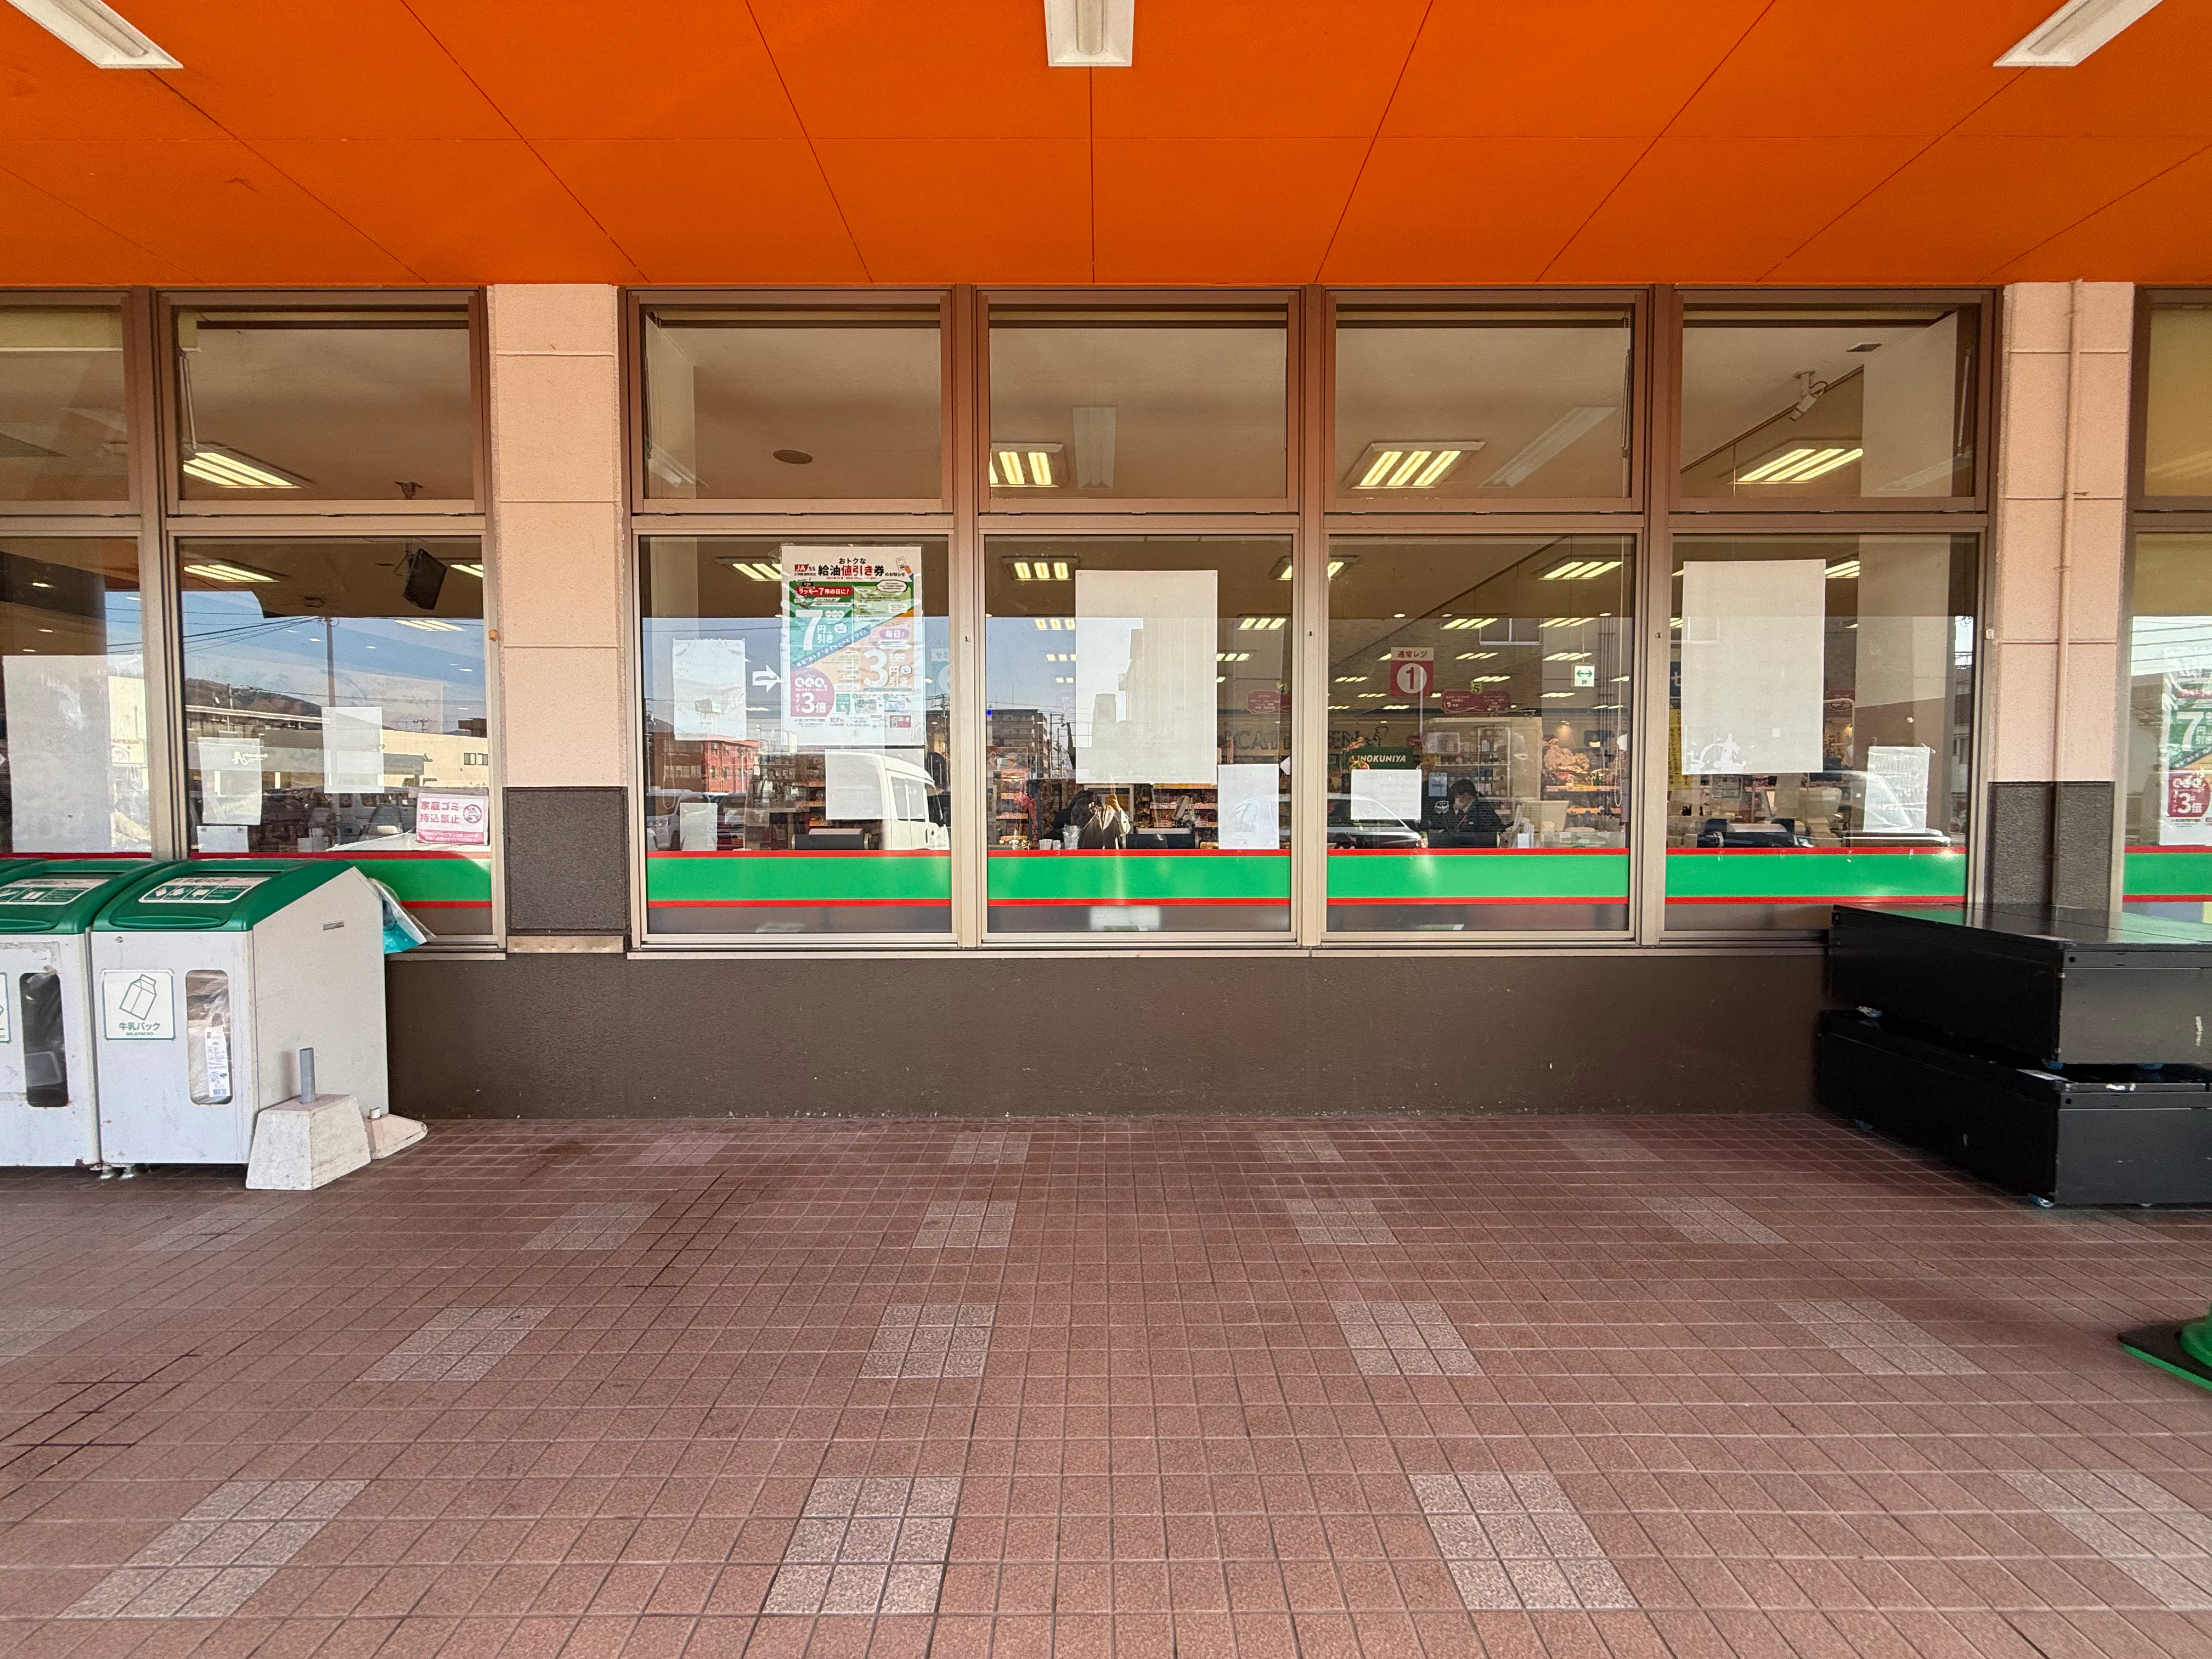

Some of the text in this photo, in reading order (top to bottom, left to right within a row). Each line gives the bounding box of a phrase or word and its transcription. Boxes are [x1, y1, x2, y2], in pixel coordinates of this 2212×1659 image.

[818, 565, 884, 577] 給油値引き券
[795, 610, 823, 651] 7
[817, 625, 826, 634] 円
[885, 630, 905, 638] 毎日!
[816, 634, 833, 644] 引き
[863, 648, 888, 688] 3
[889, 666, 899, 676] 円
[889, 676, 909, 687] 引き
[1406, 667, 1415, 690] 1
[1473, 682, 1480, 692] 5
[801, 692, 815, 714] 3
[815, 702, 827, 713] 倍
[2176, 711, 2204, 752] 7
[420, 800, 459, 811] 家庭ゴミ
[2177, 792, 2192, 814] 3
[419, 813, 460, 824] 持込禁止
[119, 1022, 160, 1031] 牛乳パック
